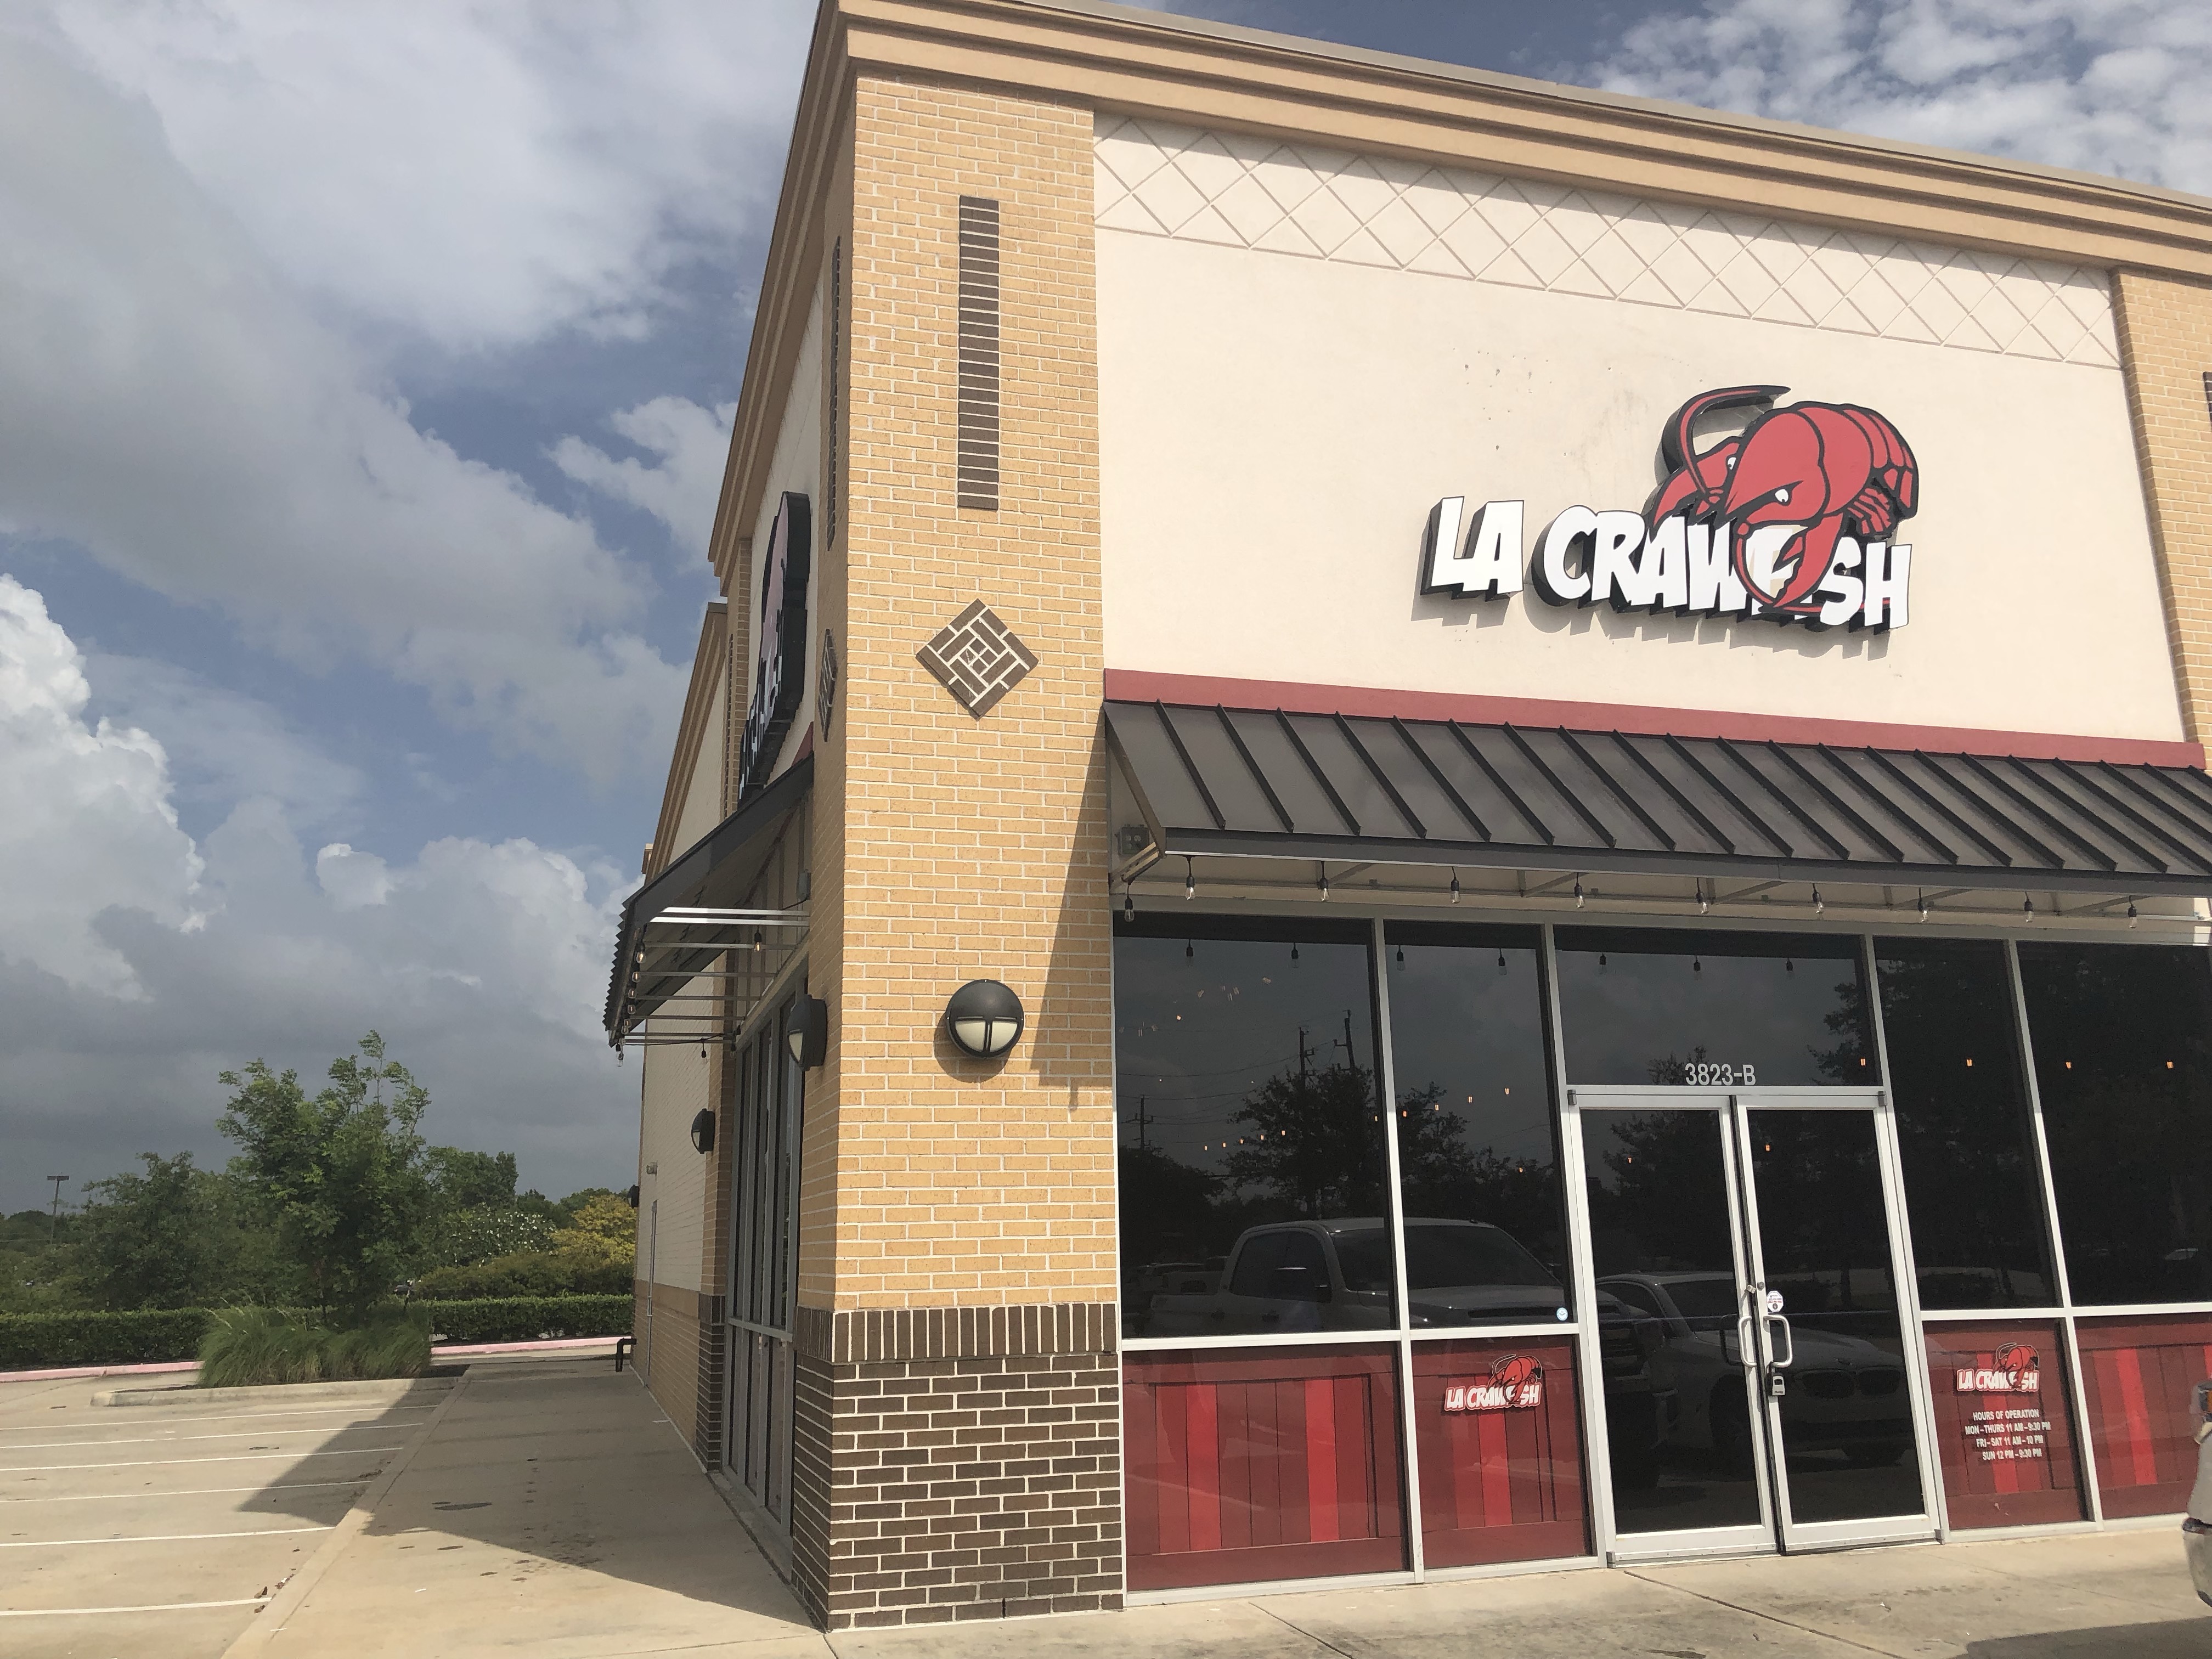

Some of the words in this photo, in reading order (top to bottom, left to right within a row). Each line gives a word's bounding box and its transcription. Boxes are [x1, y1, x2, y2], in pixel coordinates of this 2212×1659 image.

[1430, 495, 1525, 594] LA
[1543, 504, 1912, 628] CRAWFSH
[1685, 1063, 1756, 1086] 3823-B
[1958, 1371, 1973, 1390] LA
[1976, 1370, 2038, 1390] CRAWFSH
[1446, 1387, 1464, 1409] LA
[1466, 1384, 1540, 1408] CRAWFSH
[1973, 1411, 1995, 1421] HOURS
[1996, 1410, 2004, 1419] OF
[2005, 1409, 2039, 1419] OPERATION
[2006, 1423, 2013, 1432] 11
[2041, 1421, 2051, 1430] PM
[2004, 1436, 2011, 1446] 11
[2034, 1435, 2044, 1444] PM
[1983, 1451, 1996, 1460] SUN
[1997, 1450, 2004, 1459] 12
[2033, 1448, 2042, 1457] PM
